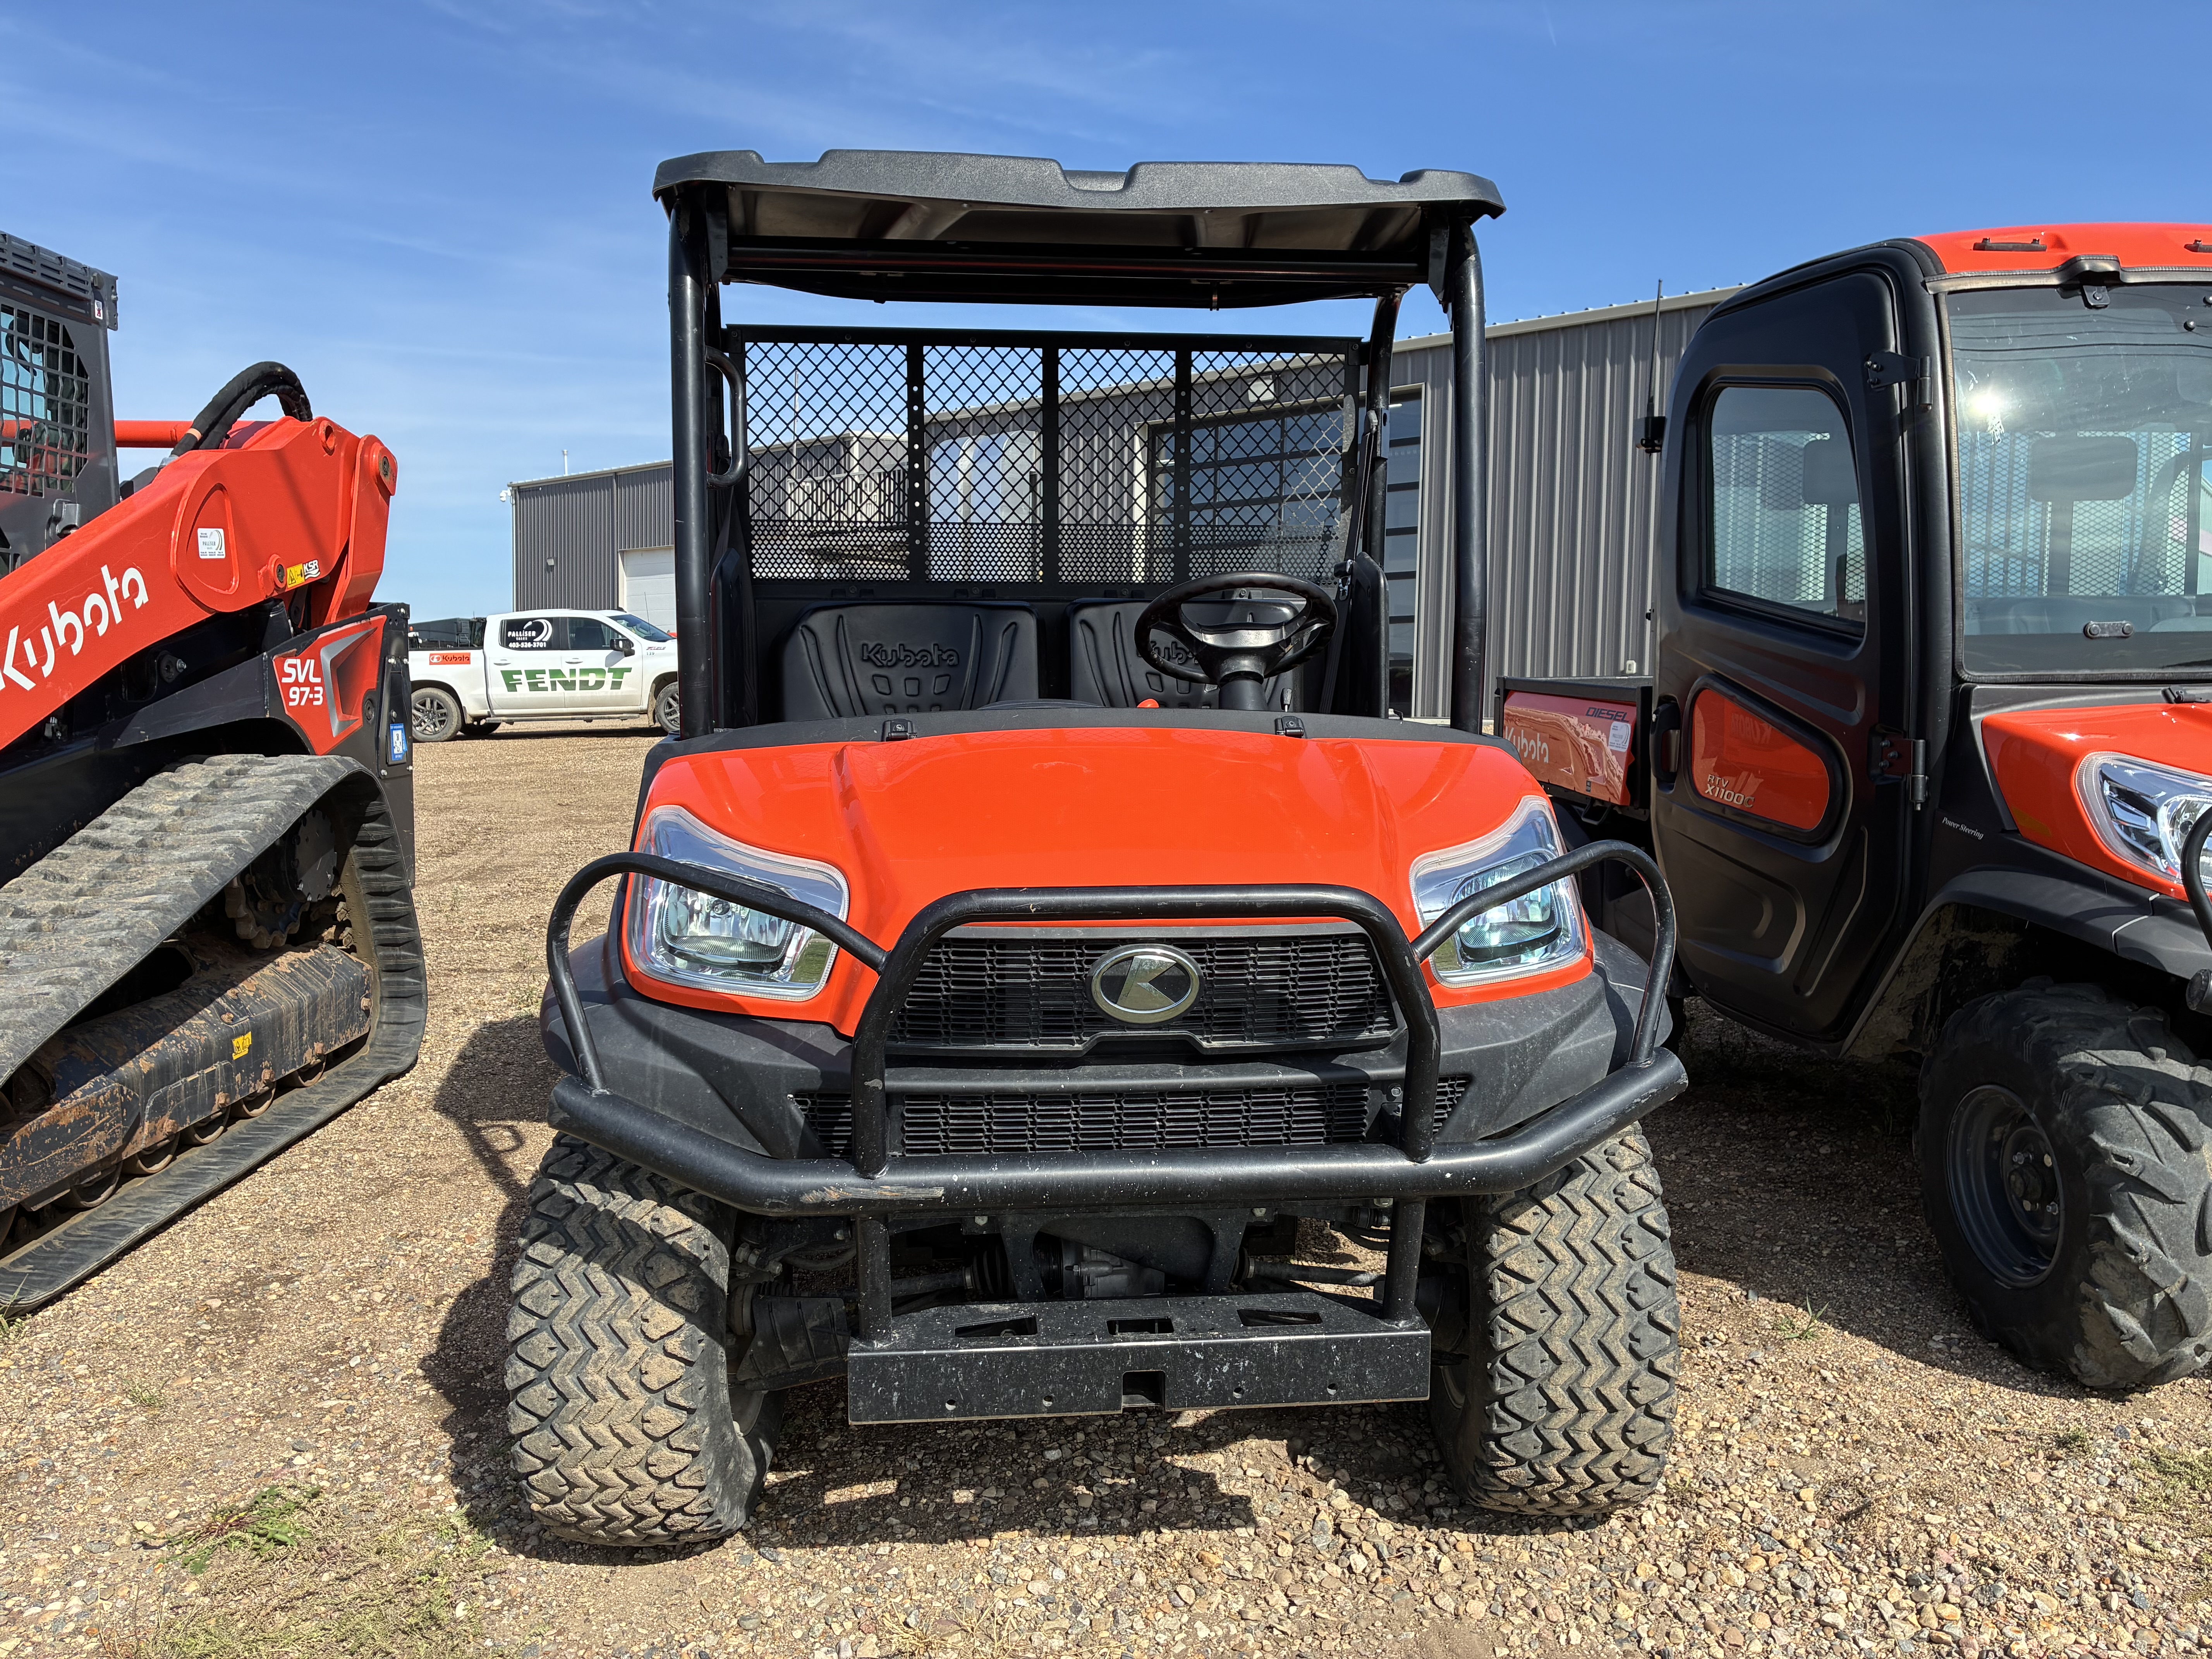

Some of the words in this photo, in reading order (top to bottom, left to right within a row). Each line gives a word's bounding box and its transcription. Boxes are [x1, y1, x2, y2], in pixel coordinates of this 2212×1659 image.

[303, 560, 319, 573] KSR
[0, 564, 149, 691] Kubota
[862, 643, 959, 666] Kubota
[282, 659, 321, 683] SVL
[500, 667, 632, 692] FENDT
[289, 686, 323, 706] 97-3
[1585, 707, 1629, 722] DIESEL
[1707, 774, 1729, 787] RTV
[1705, 783, 1755, 808] X1100C
[1942, 817, 1960, 828] Power
[1959, 824, 1984, 840] Steering
